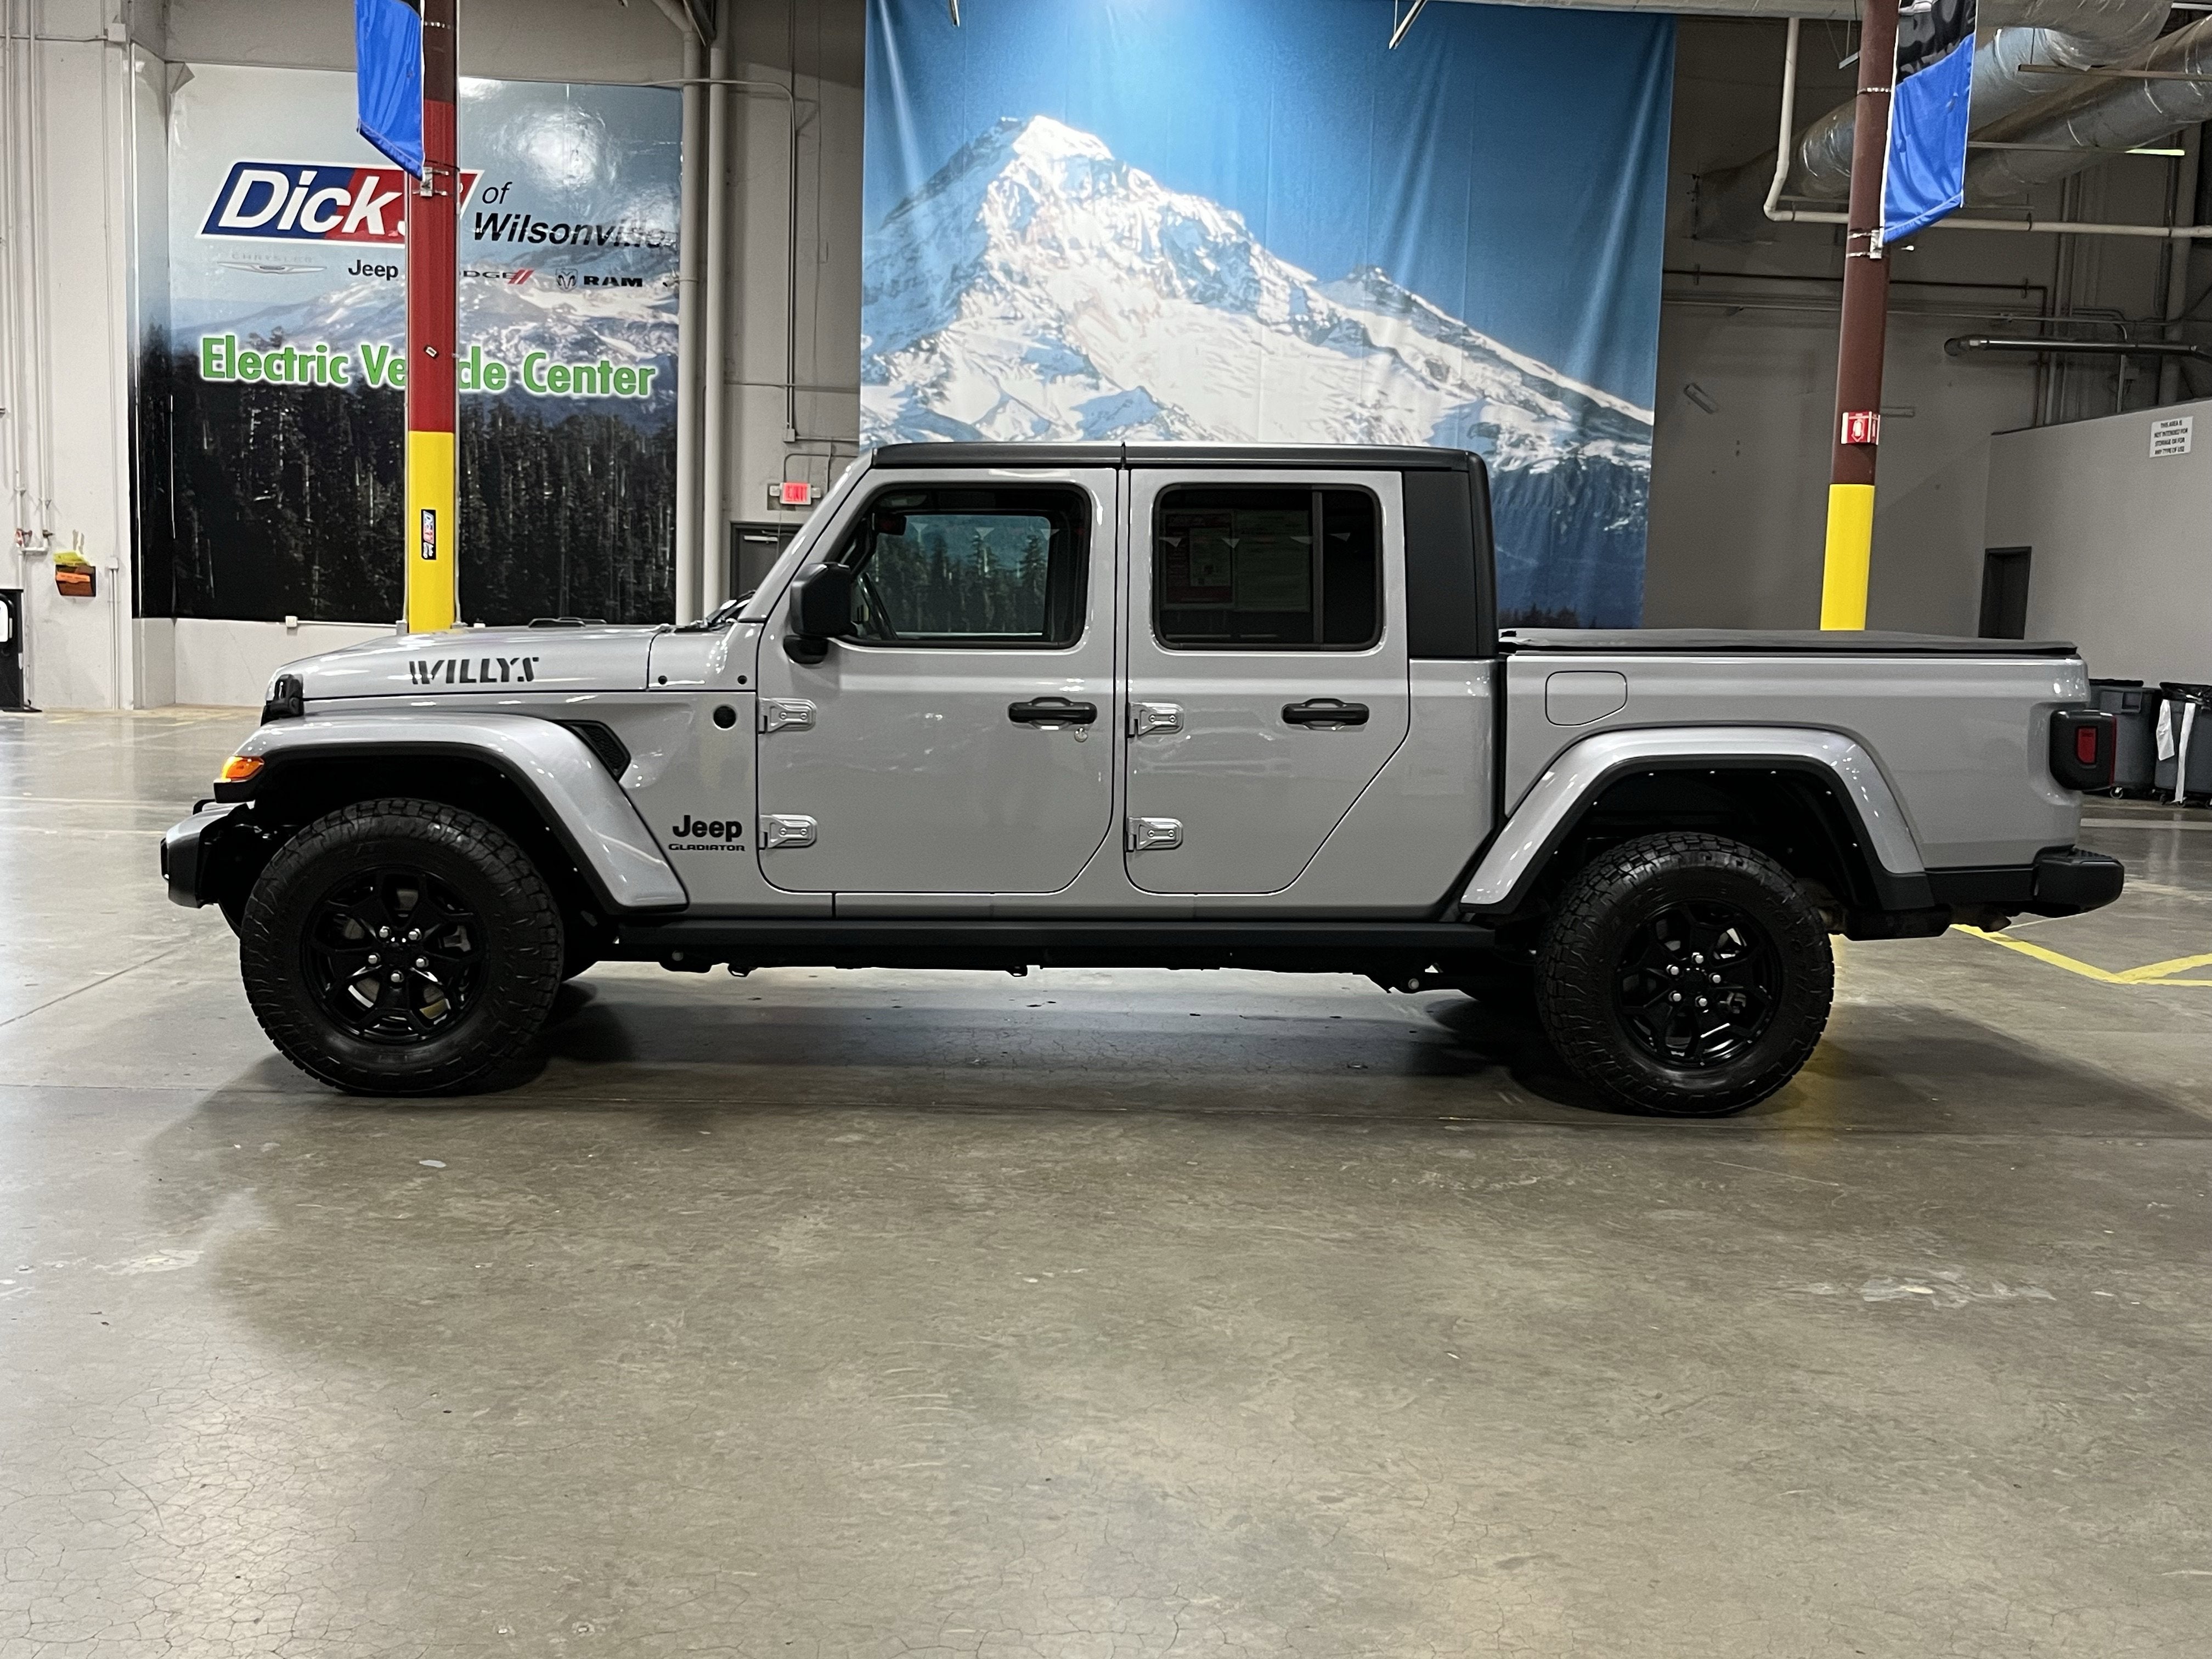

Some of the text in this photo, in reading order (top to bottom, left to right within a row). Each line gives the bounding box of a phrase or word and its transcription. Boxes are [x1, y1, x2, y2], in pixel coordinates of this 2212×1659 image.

[218, 169, 405, 236] Dick
[482, 182, 512, 204] of
[348, 259, 398, 280] Jeep
[460, 270, 517, 279] DGE
[584, 276, 643, 287] RAM
[203, 335, 656, 396] Electric Vecle Center
[409, 657, 539, 685] WILLYS
[673, 815, 743, 842] Jeep
[668, 843, 746, 851] GLADIATOR
